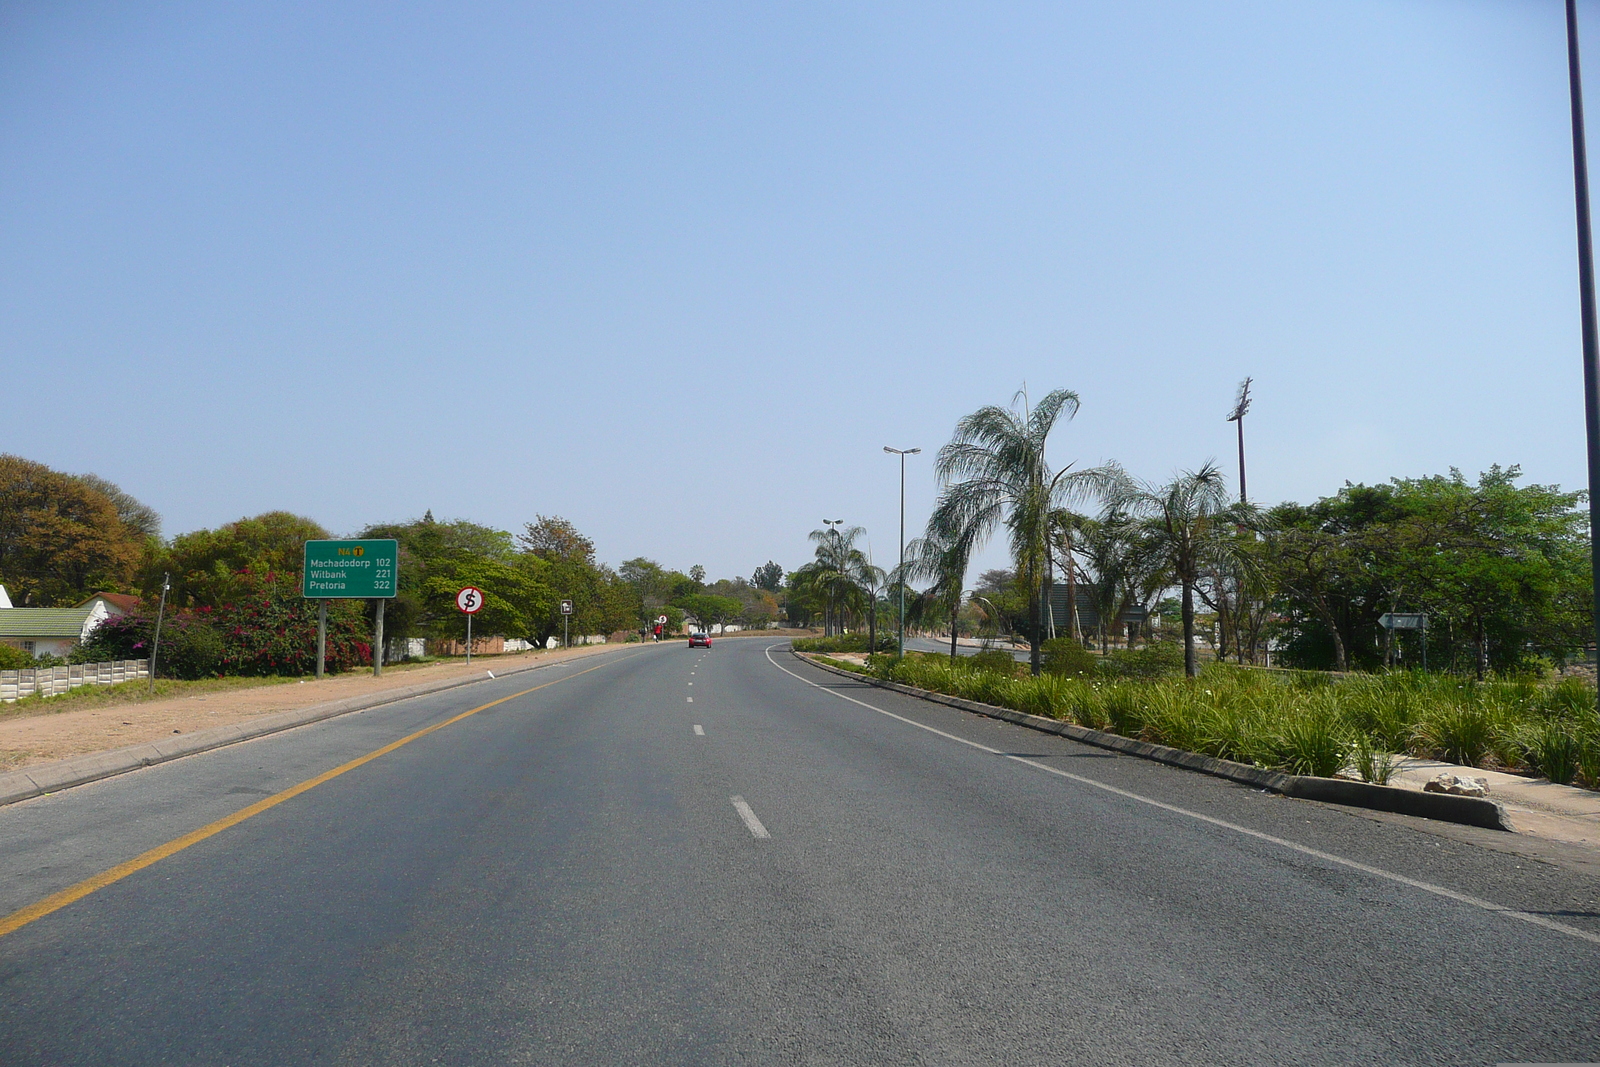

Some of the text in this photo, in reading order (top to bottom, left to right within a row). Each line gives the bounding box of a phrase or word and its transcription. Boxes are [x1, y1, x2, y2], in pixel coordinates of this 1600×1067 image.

[355, 548, 362, 556] T
[310, 558, 390, 568] Machadodorp 102
[310, 570, 390, 578] Witbank 221
[310, 581, 390, 590] Pretoria 322
